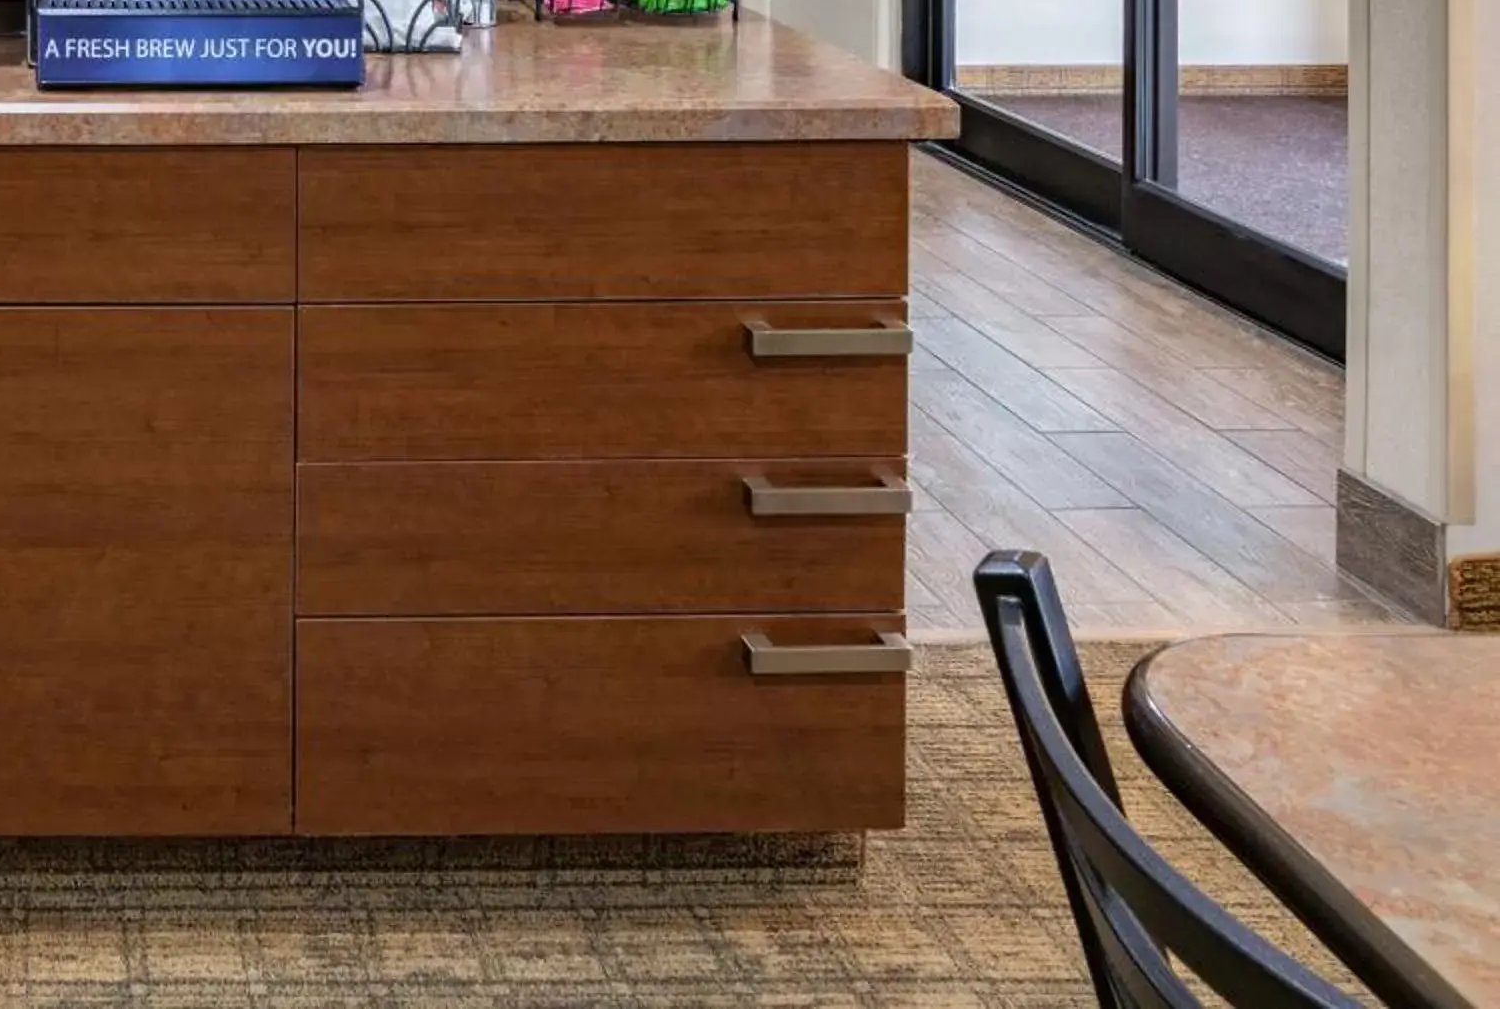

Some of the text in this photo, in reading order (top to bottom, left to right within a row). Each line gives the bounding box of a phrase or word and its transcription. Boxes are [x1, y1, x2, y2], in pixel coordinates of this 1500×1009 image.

[45, 38, 358, 59] A FRESH BREW JUST FOR YOU!
